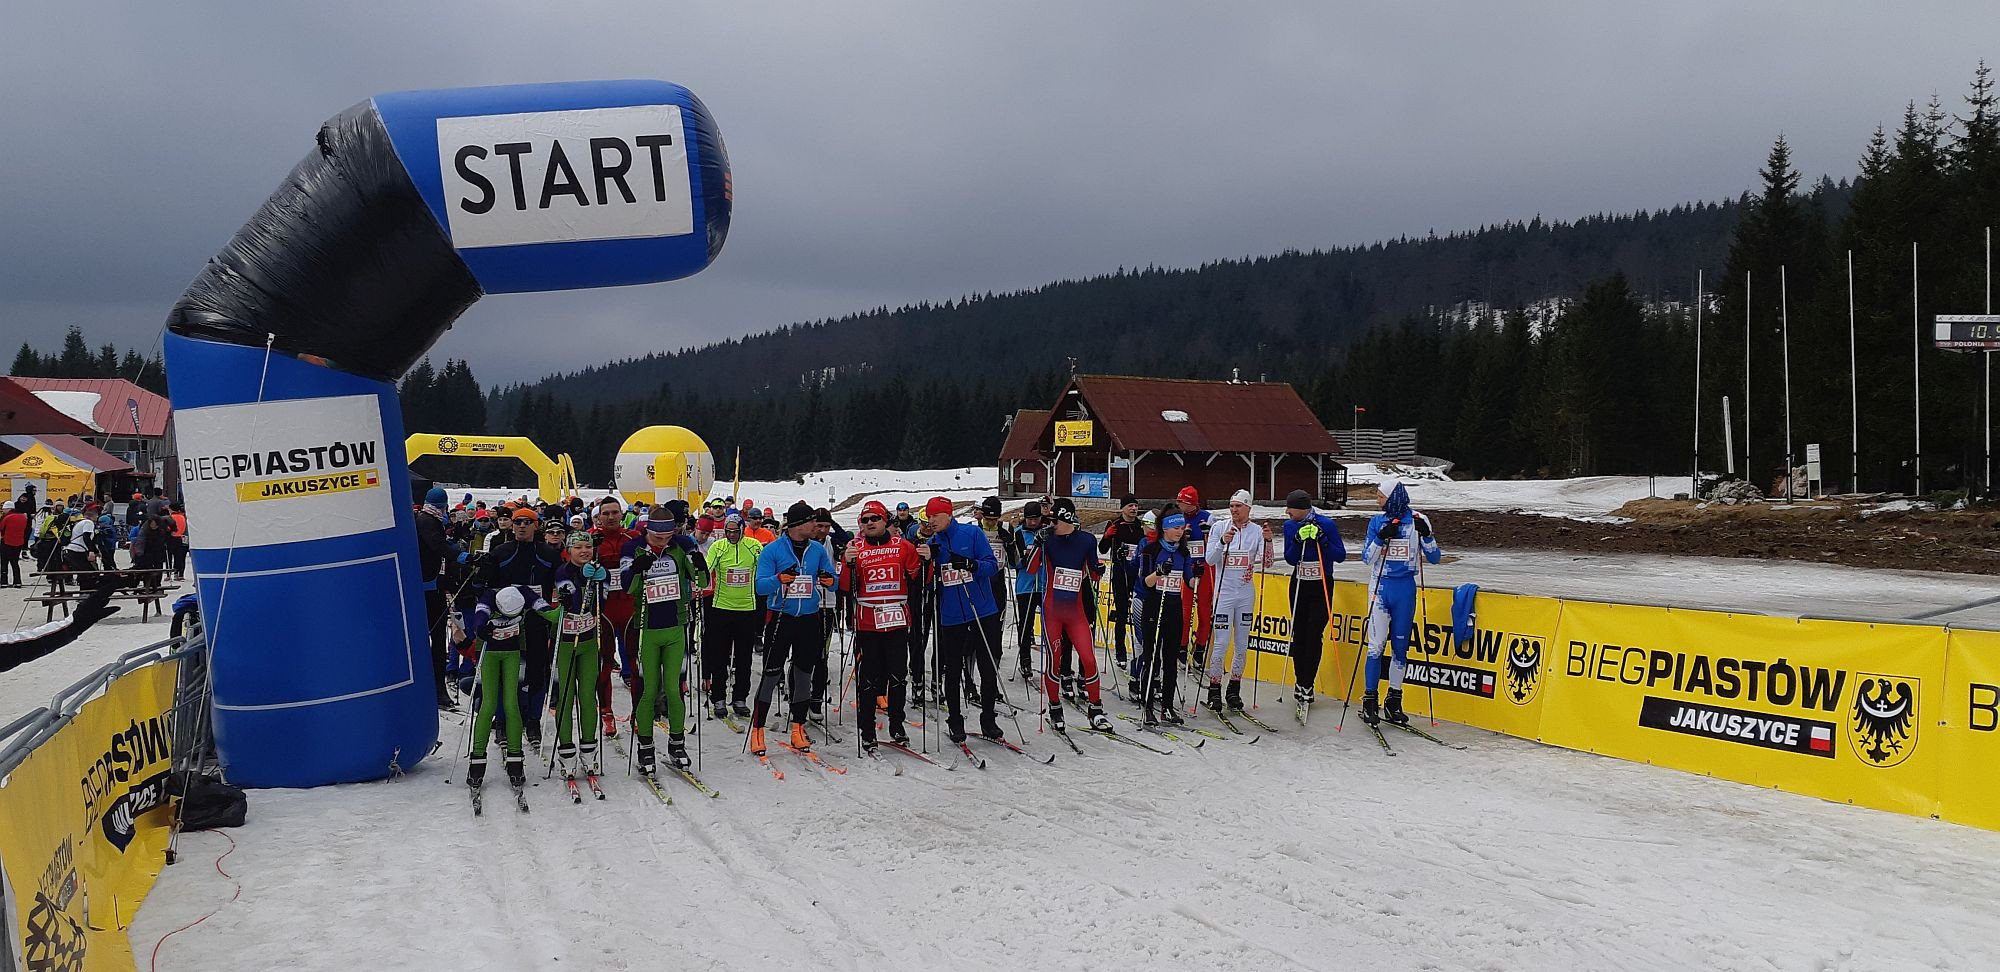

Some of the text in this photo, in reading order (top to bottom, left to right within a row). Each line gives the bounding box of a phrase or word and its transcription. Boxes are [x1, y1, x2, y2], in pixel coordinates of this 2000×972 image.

[454, 134, 673, 214] START
[261, 474, 361, 498] JAKUSZYCE
[871, 547, 901, 556] ENERVIT
[1228, 557, 1244, 566] 97
[732, 574, 746, 583] 93
[867, 567, 894, 581] 231
[1058, 576, 1079, 587] 126
[650, 586, 677, 597] 105
[878, 609, 903, 622] 170
[1405, 666, 1477, 690] AKUSZYCE
[1670, 706, 1801, 747] JAKUSZYCE
